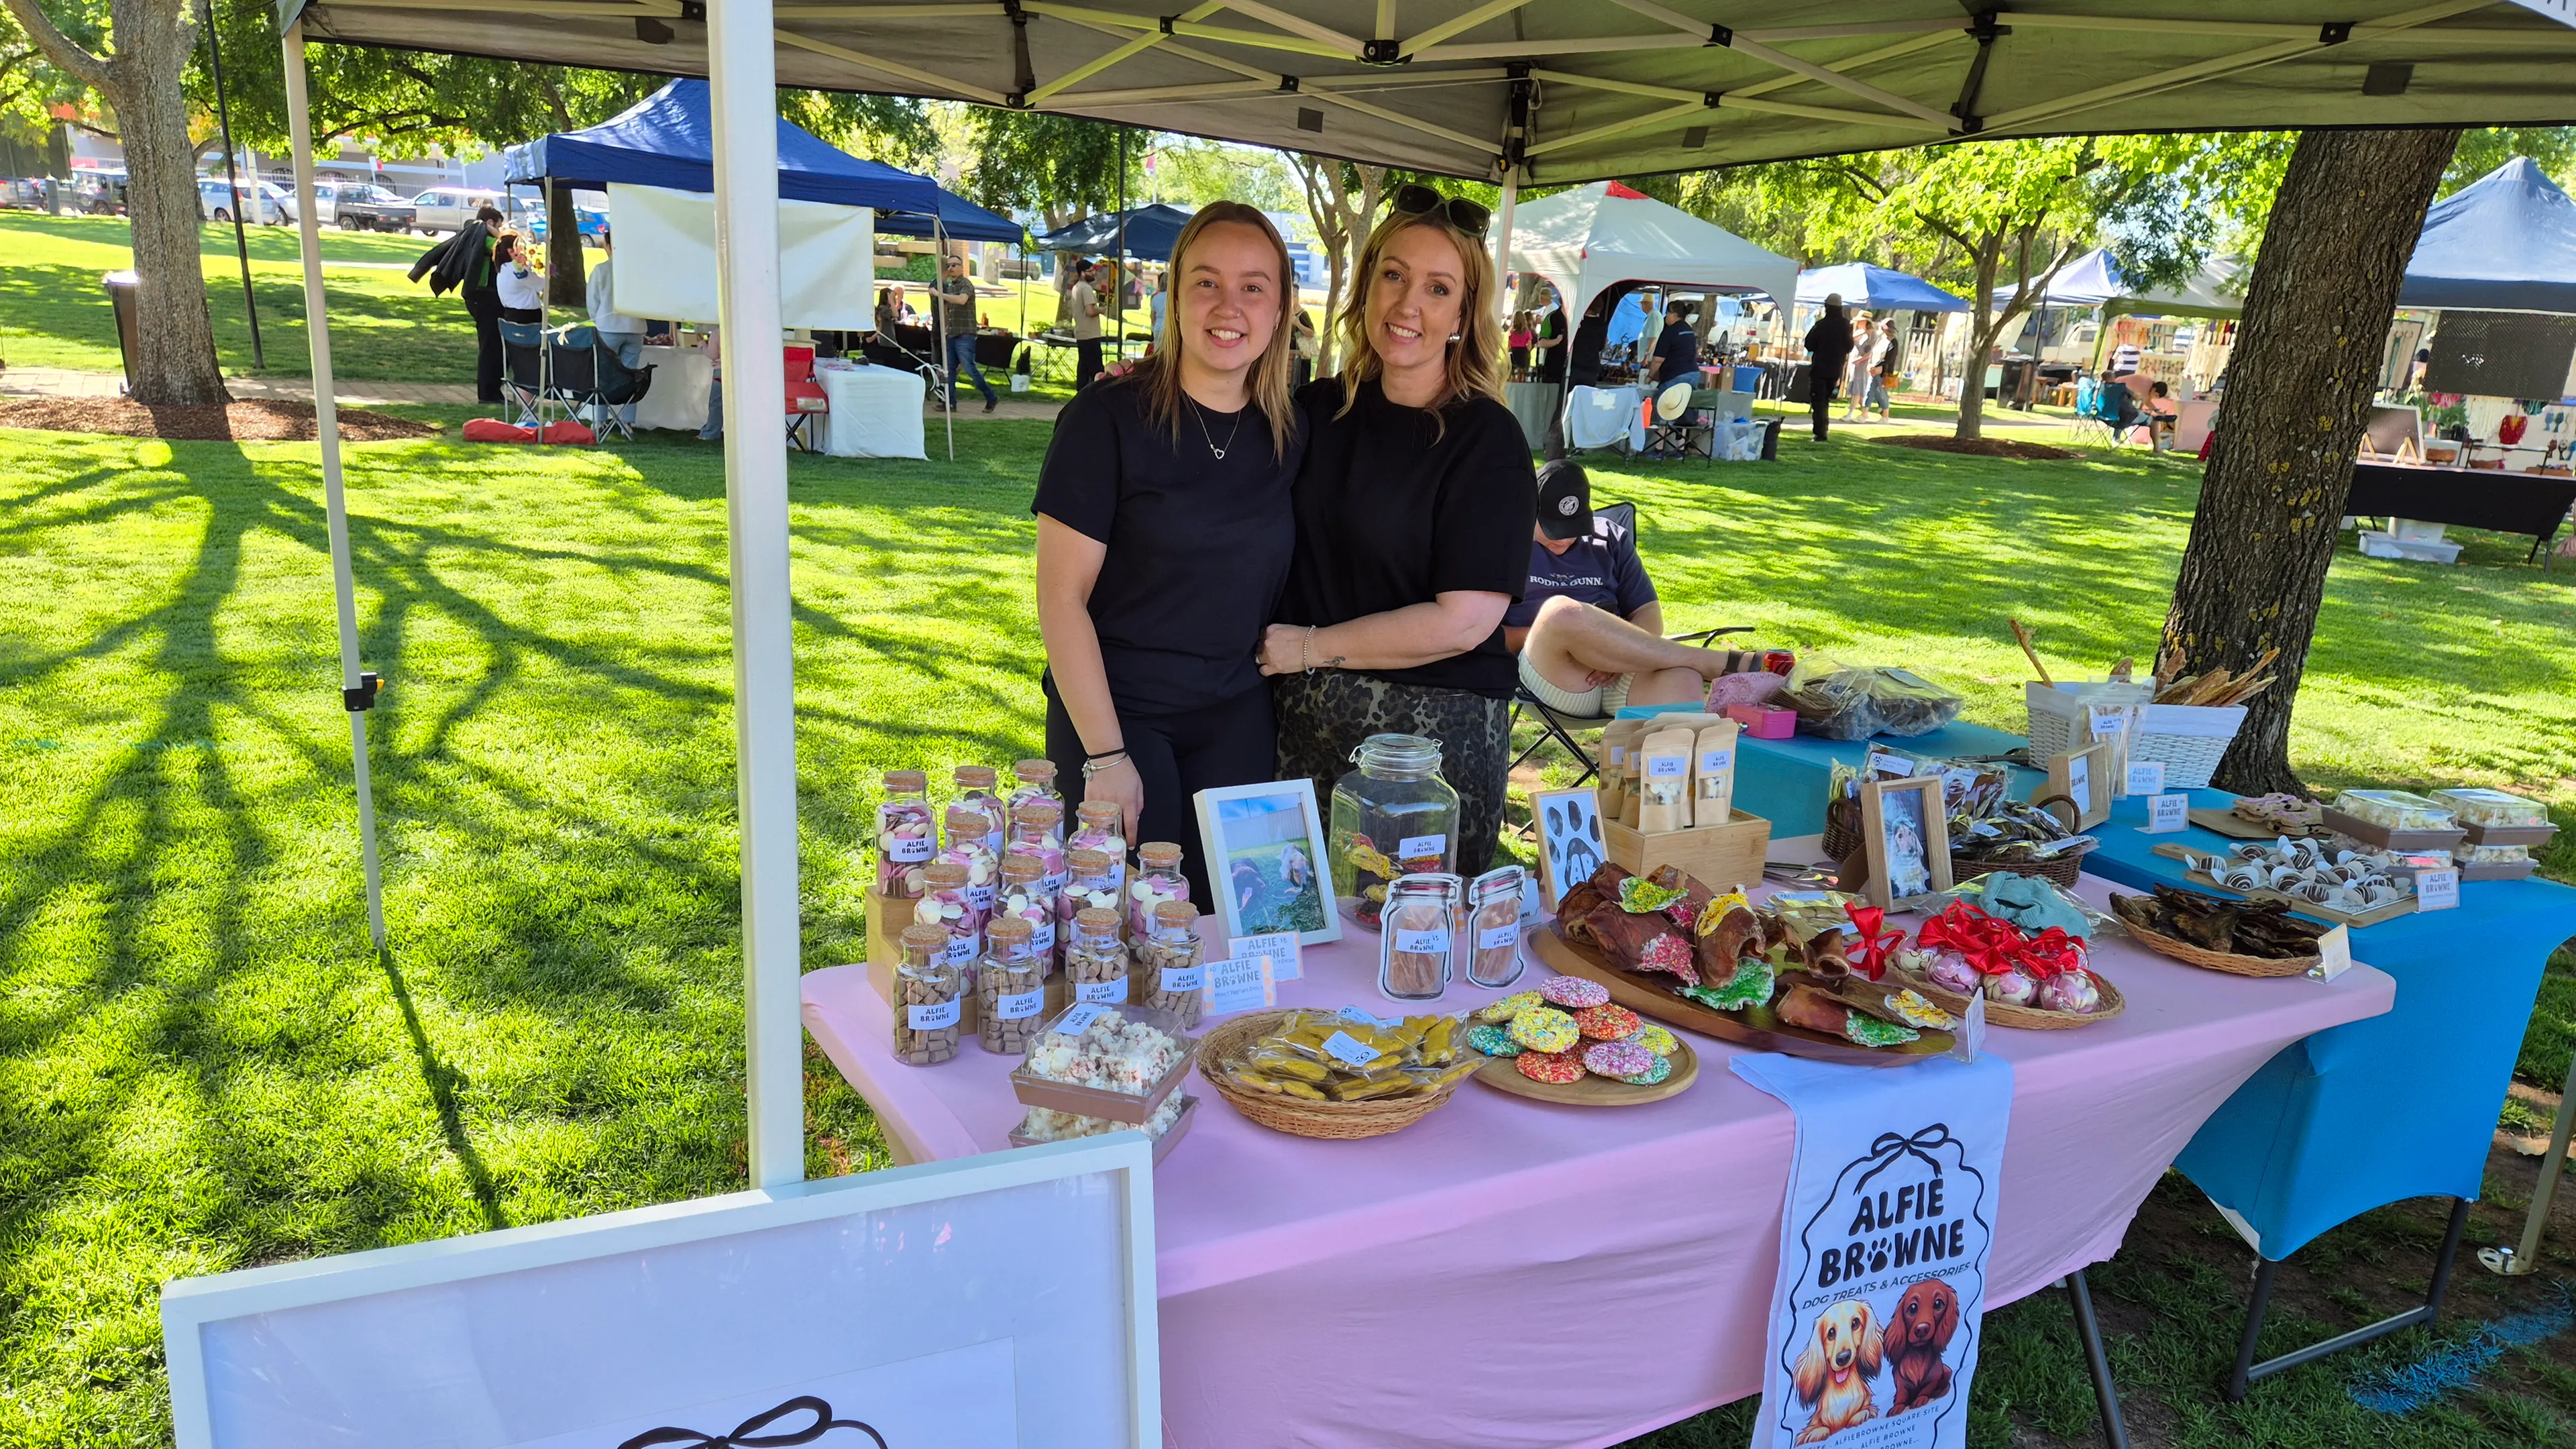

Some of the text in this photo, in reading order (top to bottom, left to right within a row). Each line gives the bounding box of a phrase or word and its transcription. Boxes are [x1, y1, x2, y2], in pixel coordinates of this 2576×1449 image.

[1529, 576, 1560, 586] RODD
[2133, 767, 2152, 775] ALFIE
[2161, 799, 2178, 808] ALFIE
[906, 840, 925, 848] ALFIE
[2429, 873, 2447, 883] ALFIE
[970, 890, 987, 898] ALFIE
[948, 943, 967, 952] ALFIE
[1248, 936, 1277, 950] ALFIE
[1221, 960, 1251, 975] ALFIE
[1177, 973, 1195, 982] ALFIE
[1091, 985, 1110, 994] ALFIE
[1015, 997, 1033, 1006] ALFIE
[926, 1007, 946, 1015] ALFIE
[1847, 1178, 1944, 1236] ALFIE
[1802, 1262, 1972, 1310] DOG TREATS & ACCESSORIES
[1860, 1424, 1917, 1449] ALFIE BROWNE
